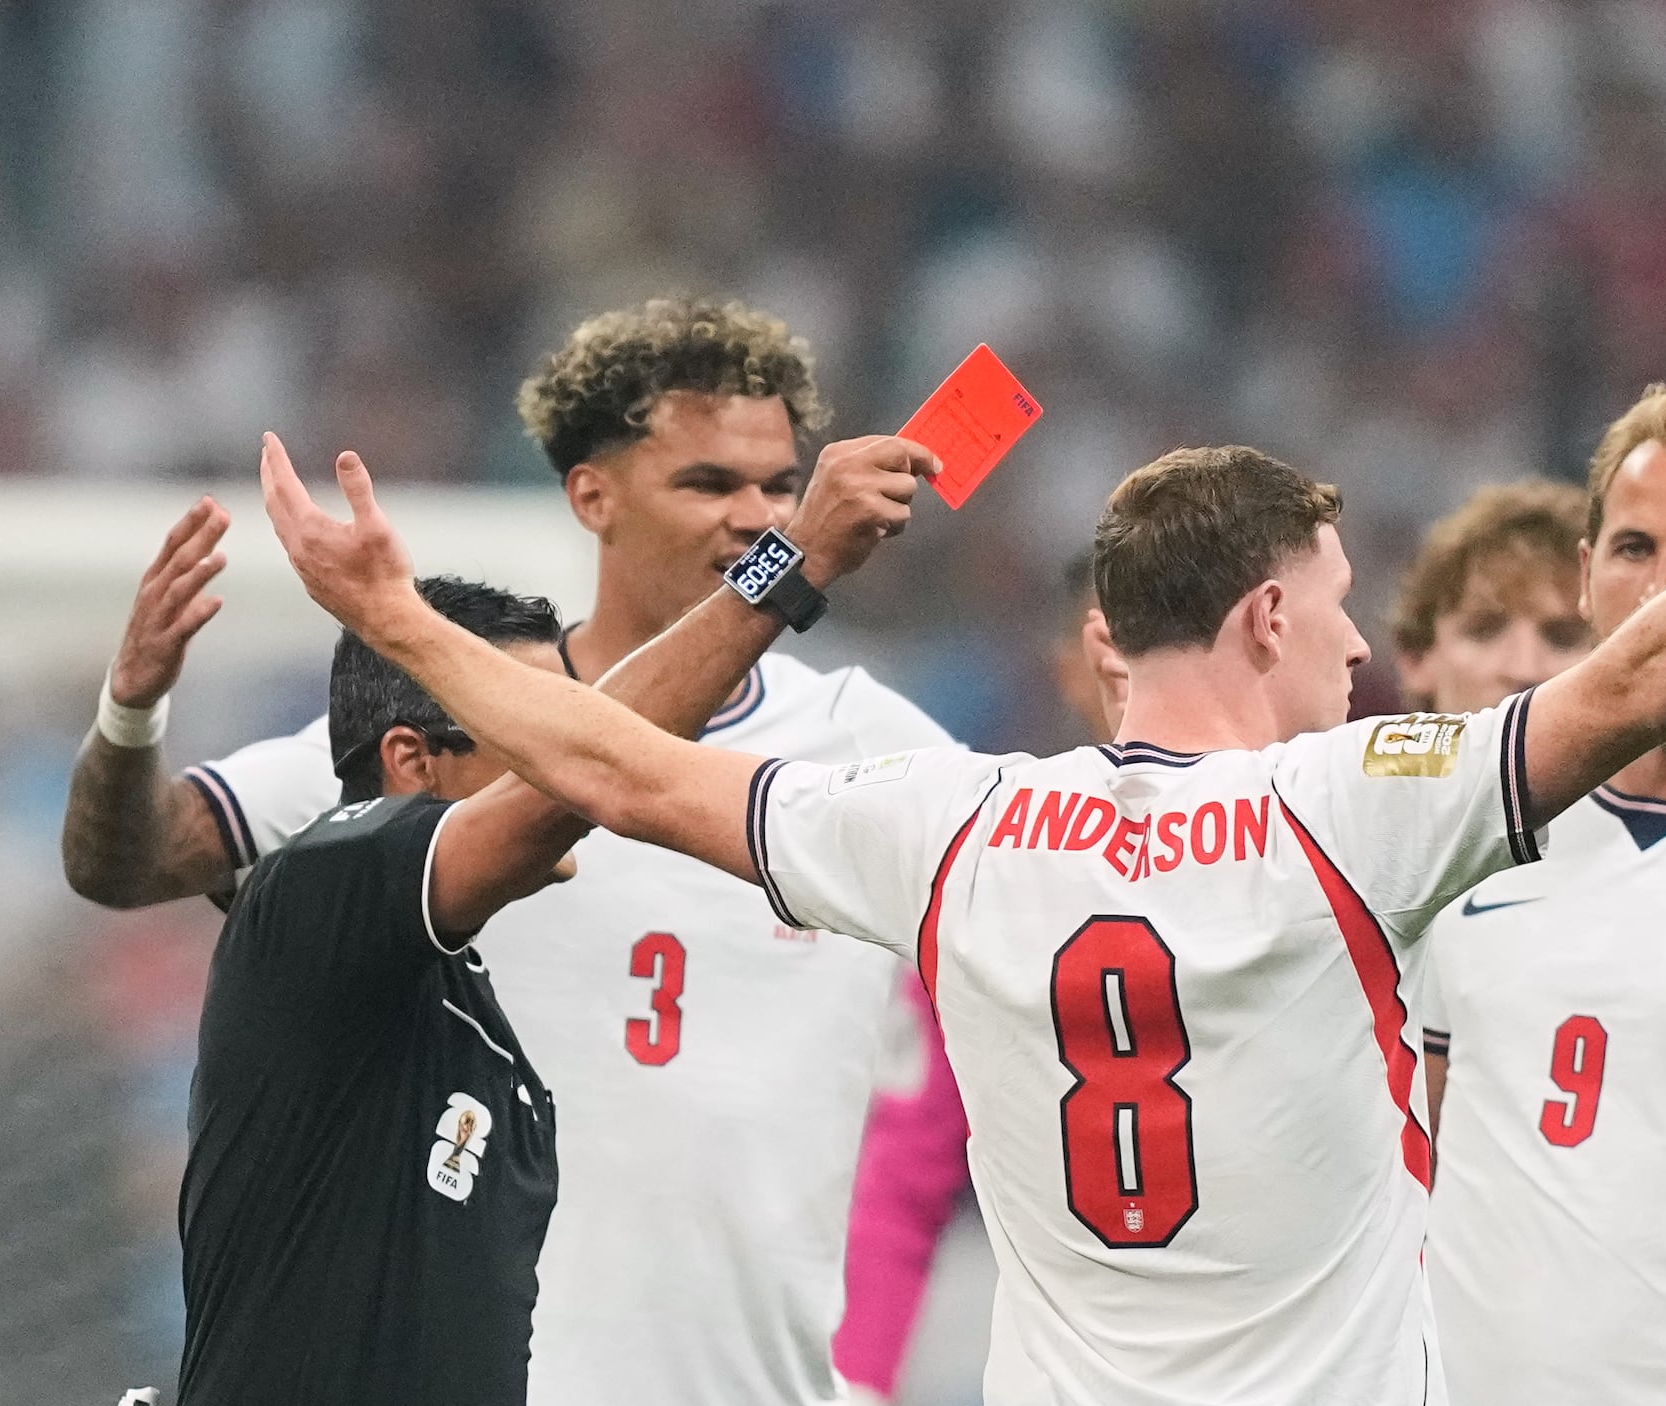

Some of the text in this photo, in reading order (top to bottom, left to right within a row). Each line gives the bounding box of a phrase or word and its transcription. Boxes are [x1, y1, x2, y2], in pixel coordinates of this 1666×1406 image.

[736, 543, 789, 595] 53:09
[987, 788, 1270, 882] ANDERSON
[625, 931, 687, 1067] 3
[1051, 914, 1199, 1249] 8
[1539, 1014, 1609, 1148] 9
[436, 1171, 459, 1189] FIFA
